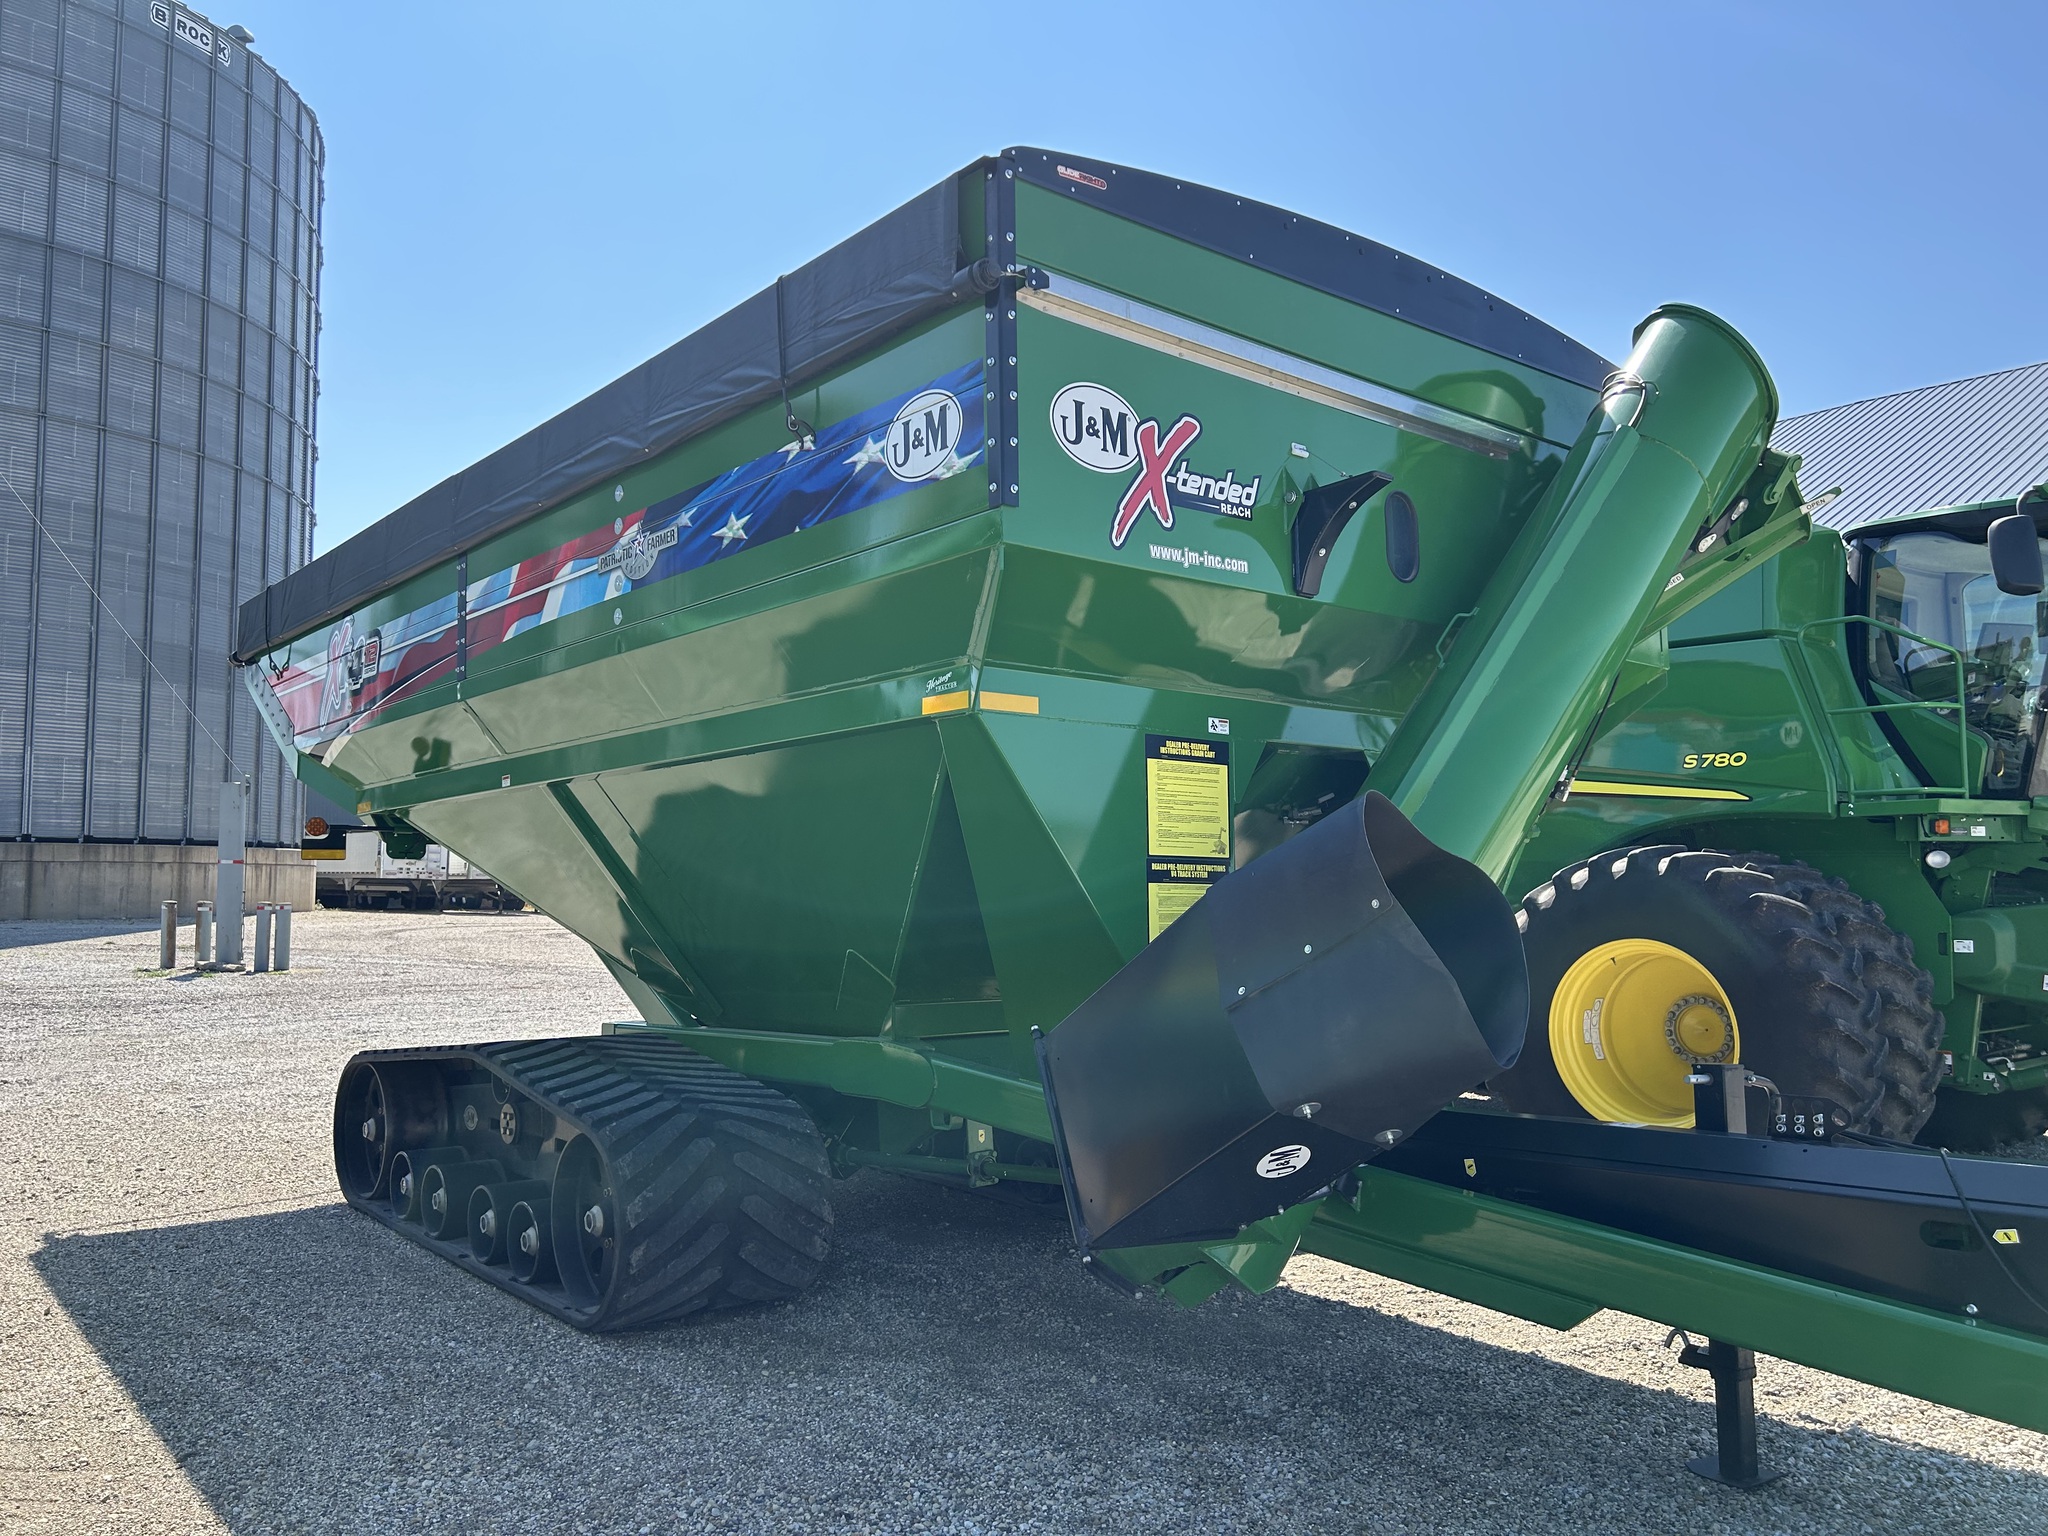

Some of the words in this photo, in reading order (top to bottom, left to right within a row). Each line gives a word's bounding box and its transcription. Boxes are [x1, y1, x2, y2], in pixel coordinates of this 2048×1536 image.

[154, 7, 228, 59] BROCK
[892, 403, 949, 468] J&M
[1060, 399, 1129, 457] J&M
[1220, 503, 1252, 519] REACH
[1806, 498, 1826, 510] OPEN
[646, 528, 676, 551] FARMER
[1149, 543, 1249, 574] www.jm-inc.com
[1160, 747, 1190, 756] INSTRUCTIONS
[1266, 1147, 1302, 1176] J&M
